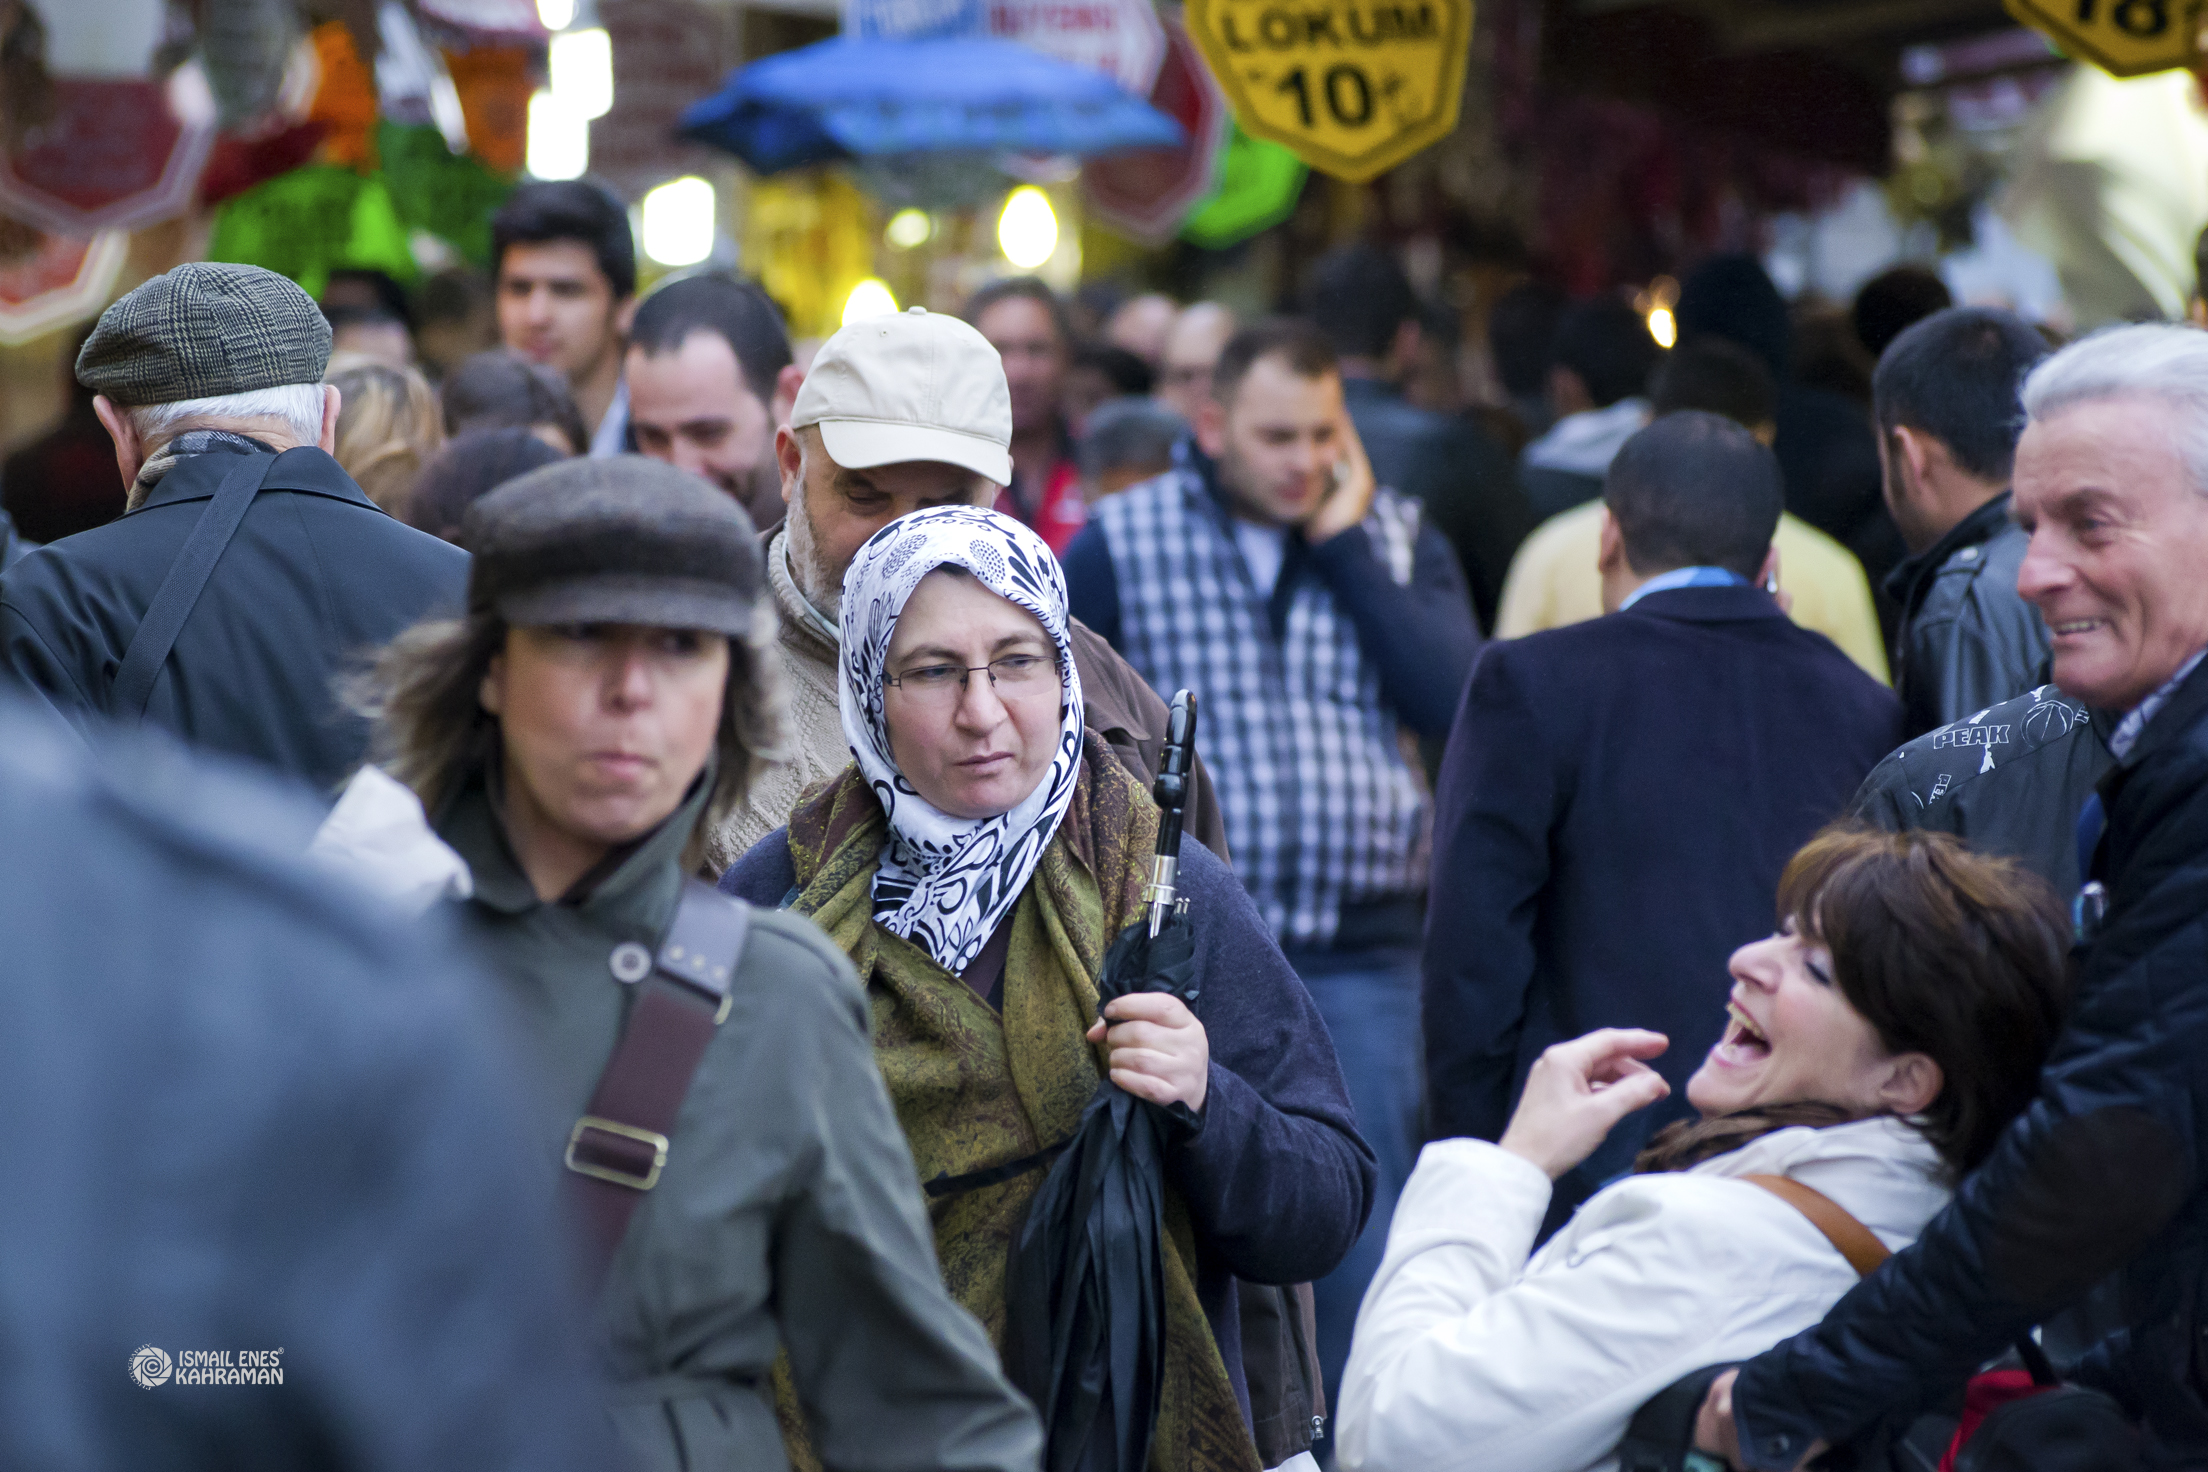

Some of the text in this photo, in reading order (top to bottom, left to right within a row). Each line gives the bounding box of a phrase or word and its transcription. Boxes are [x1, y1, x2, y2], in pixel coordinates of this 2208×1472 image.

[1221, 6, 1439, 52] LOKUM
[1276, 63, 1375, 129] 10
[1934, 725, 2010, 749] PEAK
